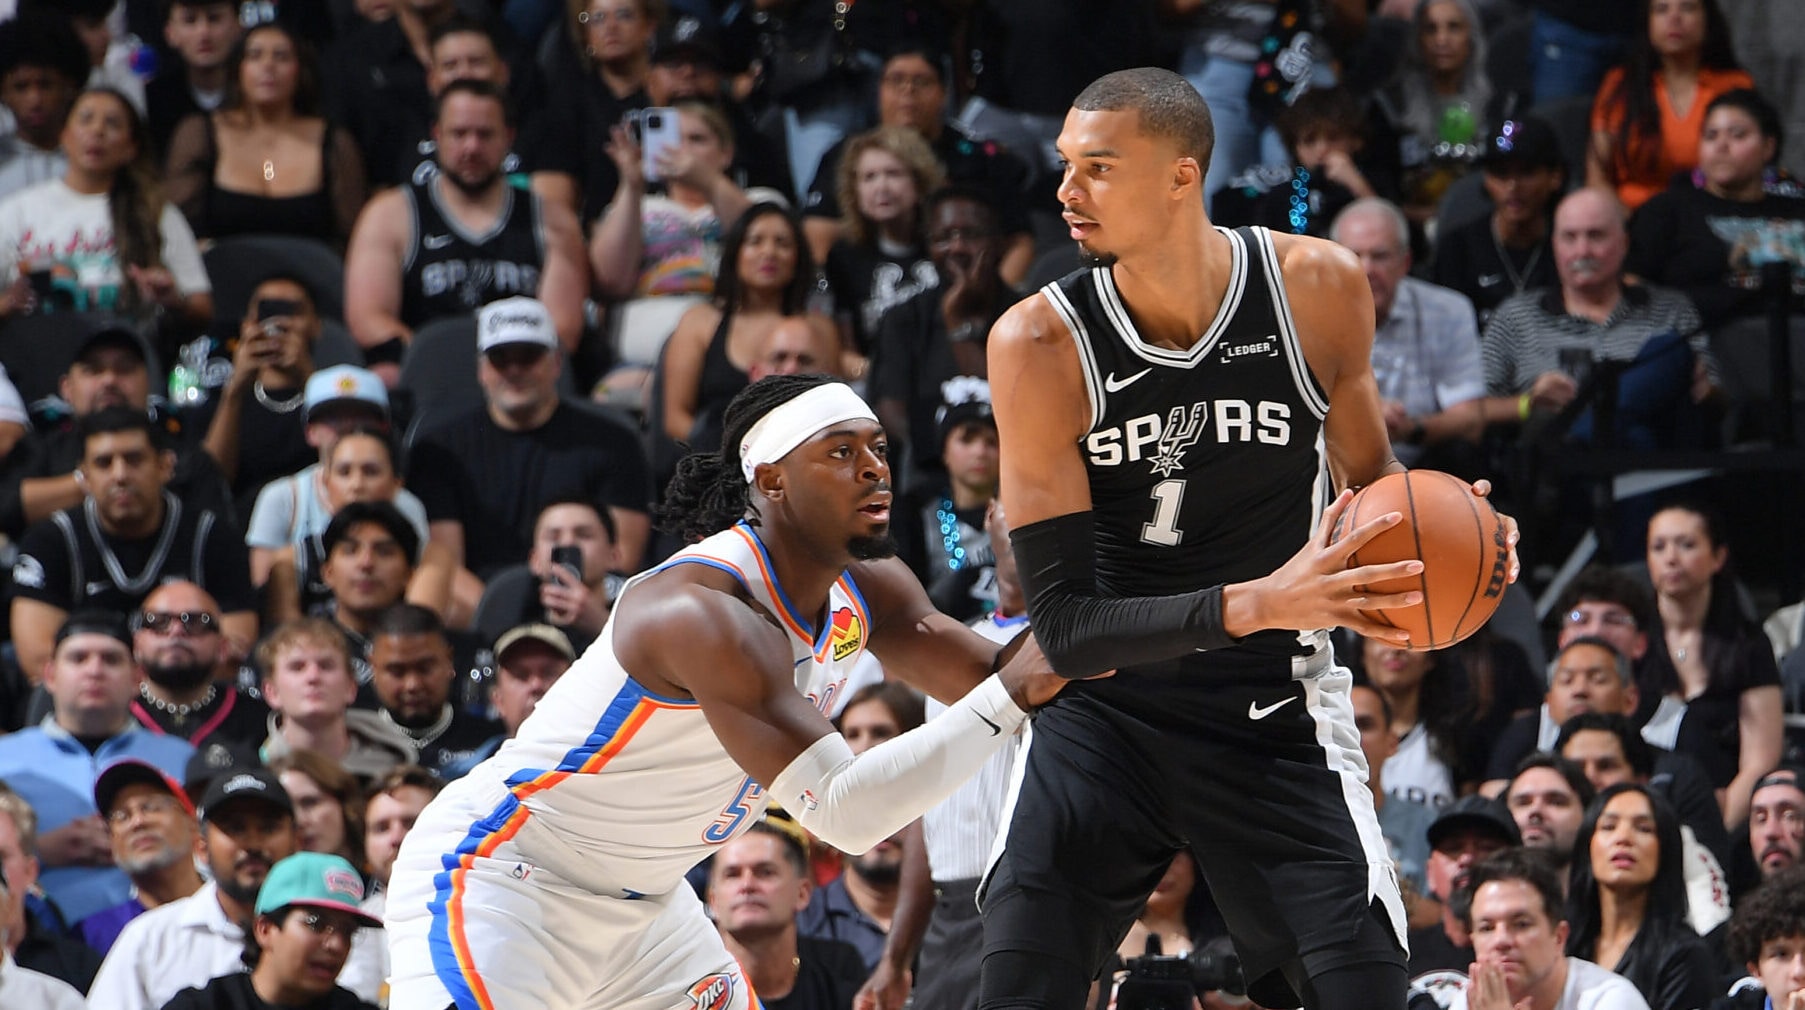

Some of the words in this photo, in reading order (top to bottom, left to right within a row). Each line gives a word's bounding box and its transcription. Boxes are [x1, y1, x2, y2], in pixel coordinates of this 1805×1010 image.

[1227, 342, 1271, 357] LEDGER
[1087, 399, 1291, 477] SPURS
[1140, 478, 1188, 547] 1
[702, 775, 766, 844] 5
